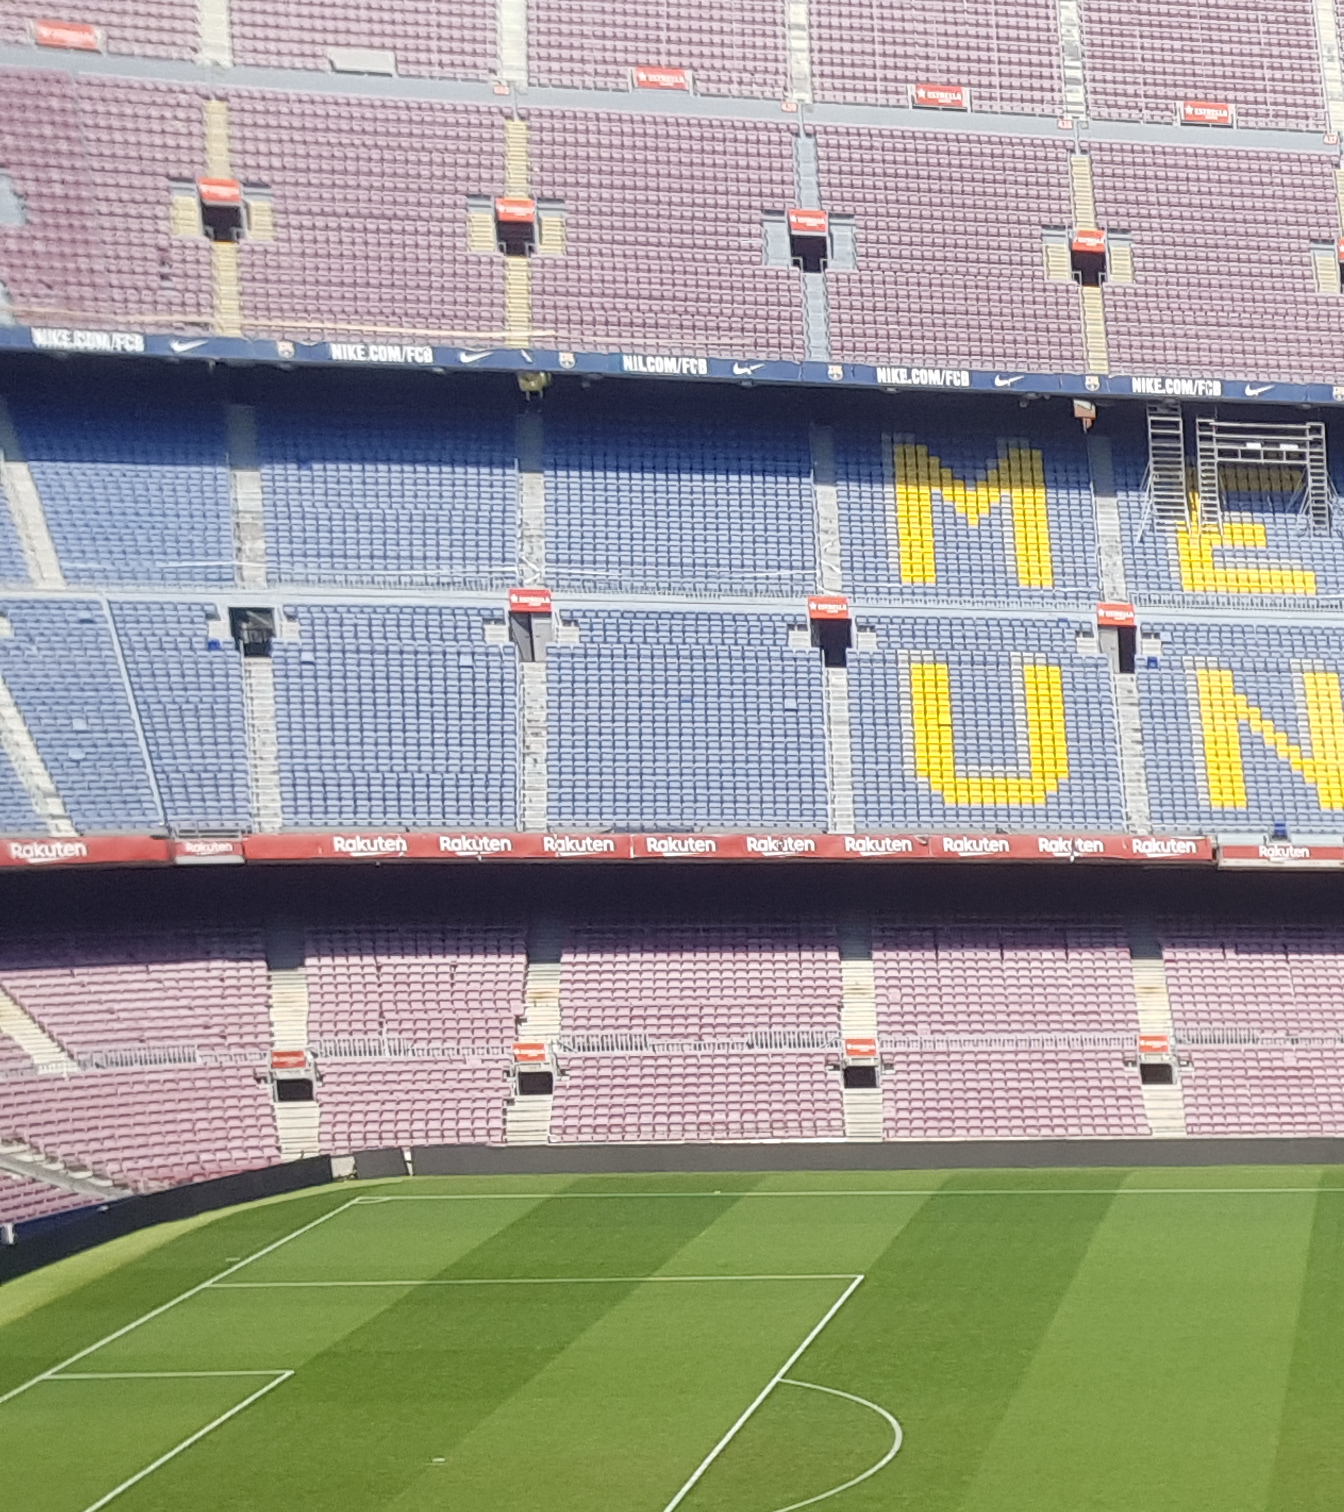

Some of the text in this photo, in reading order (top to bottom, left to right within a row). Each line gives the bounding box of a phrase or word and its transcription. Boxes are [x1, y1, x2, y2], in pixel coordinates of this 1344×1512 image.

[330, 343, 434, 363] NIKE.COM/FCB
[876, 366, 970, 386] NIKE.COM/FCB
[1131, 377, 1222, 396] NIKE.COM/FCB
[11, 842, 87, 858] Rakuten
[185, 842, 233, 853] Rakuten
[333, 836, 407, 852] Rakuten
[439, 835, 512, 851] Rakuten
[543, 836, 614, 852] Rakuten
[646, 836, 716, 852] Rakuten
[845, 836, 912, 851] Rakuten
[943, 837, 1009, 852] Rakuten
[1132, 838, 1196, 854] Rakuten
[1259, 845, 1310, 858] Rakuten
